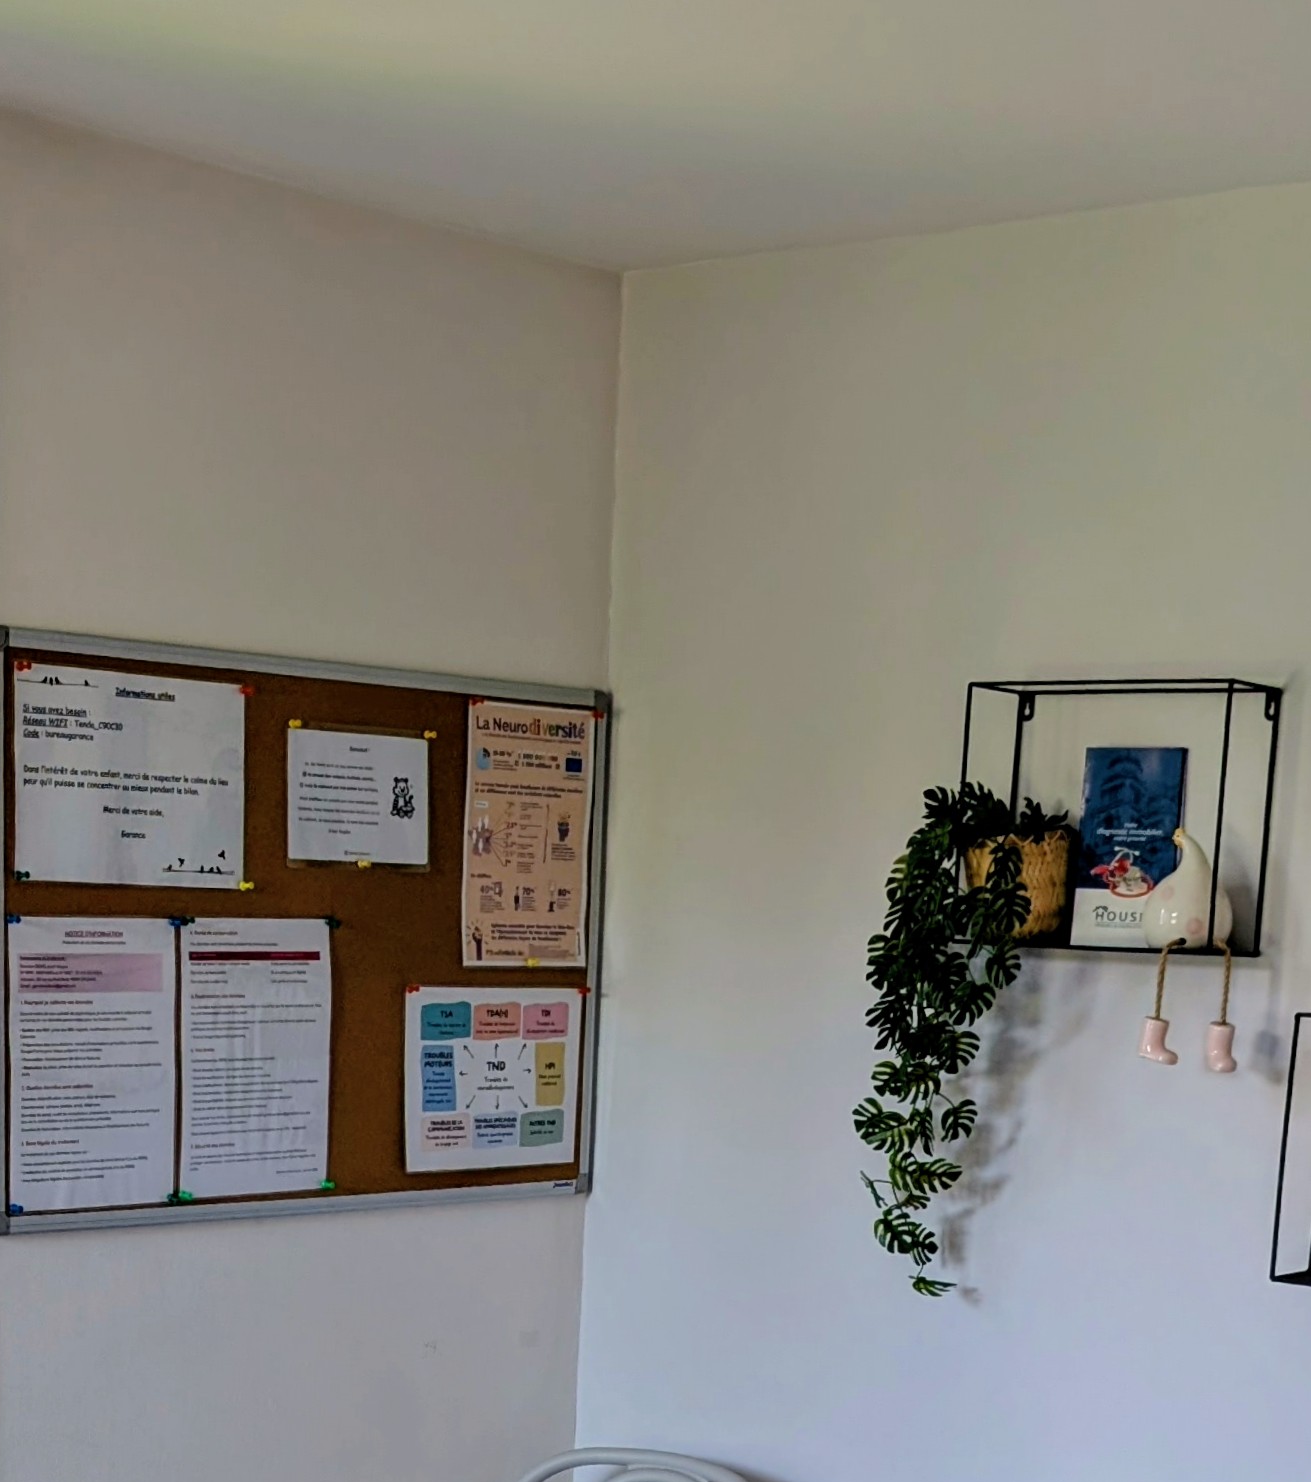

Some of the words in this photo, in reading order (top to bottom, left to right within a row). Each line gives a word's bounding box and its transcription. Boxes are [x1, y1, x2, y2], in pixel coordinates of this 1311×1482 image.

[115, 687, 155, 700] Informations
[158, 692, 175, 702] utiles
[22, 704, 29, 714] Si
[32, 706, 46, 714] vous
[48, 707, 64, 716] avez
[65, 707, 87, 717] besoin
[23, 715, 46, 727] Réseau
[49, 718, 68, 728] WIFI
[476, 715, 490, 730] La
[493, 717, 585, 740] Neurodiversité
[23, 728, 39, 738] Code
[23, 764, 39, 773] Dans
[41, 765, 68, 775] l'intérêt
[69, 768, 78, 776] de
[80, 769, 98, 777] votre
[142, 773, 149, 781] de
[151, 775, 182, 783] respecter
[183, 775, 189, 783] le
[190, 776, 207, 784] calme
[209, 778, 217, 786] du
[23, 778, 38, 787] pour
[40, 778, 52, 788] qu'il
[54, 780, 75, 788] puisse
[87, 782, 121, 790] concentrer
[131, 784, 148, 792] mieux
[150, 786, 175, 794] pendant
[176, 787, 182, 795] le
[103, 805, 120, 814] Merci
[122, 806, 129, 815] de
[131, 808, 147, 816] votre
[440, 1010, 453, 1018] TSA
[486, 1061, 506, 1072] TND
